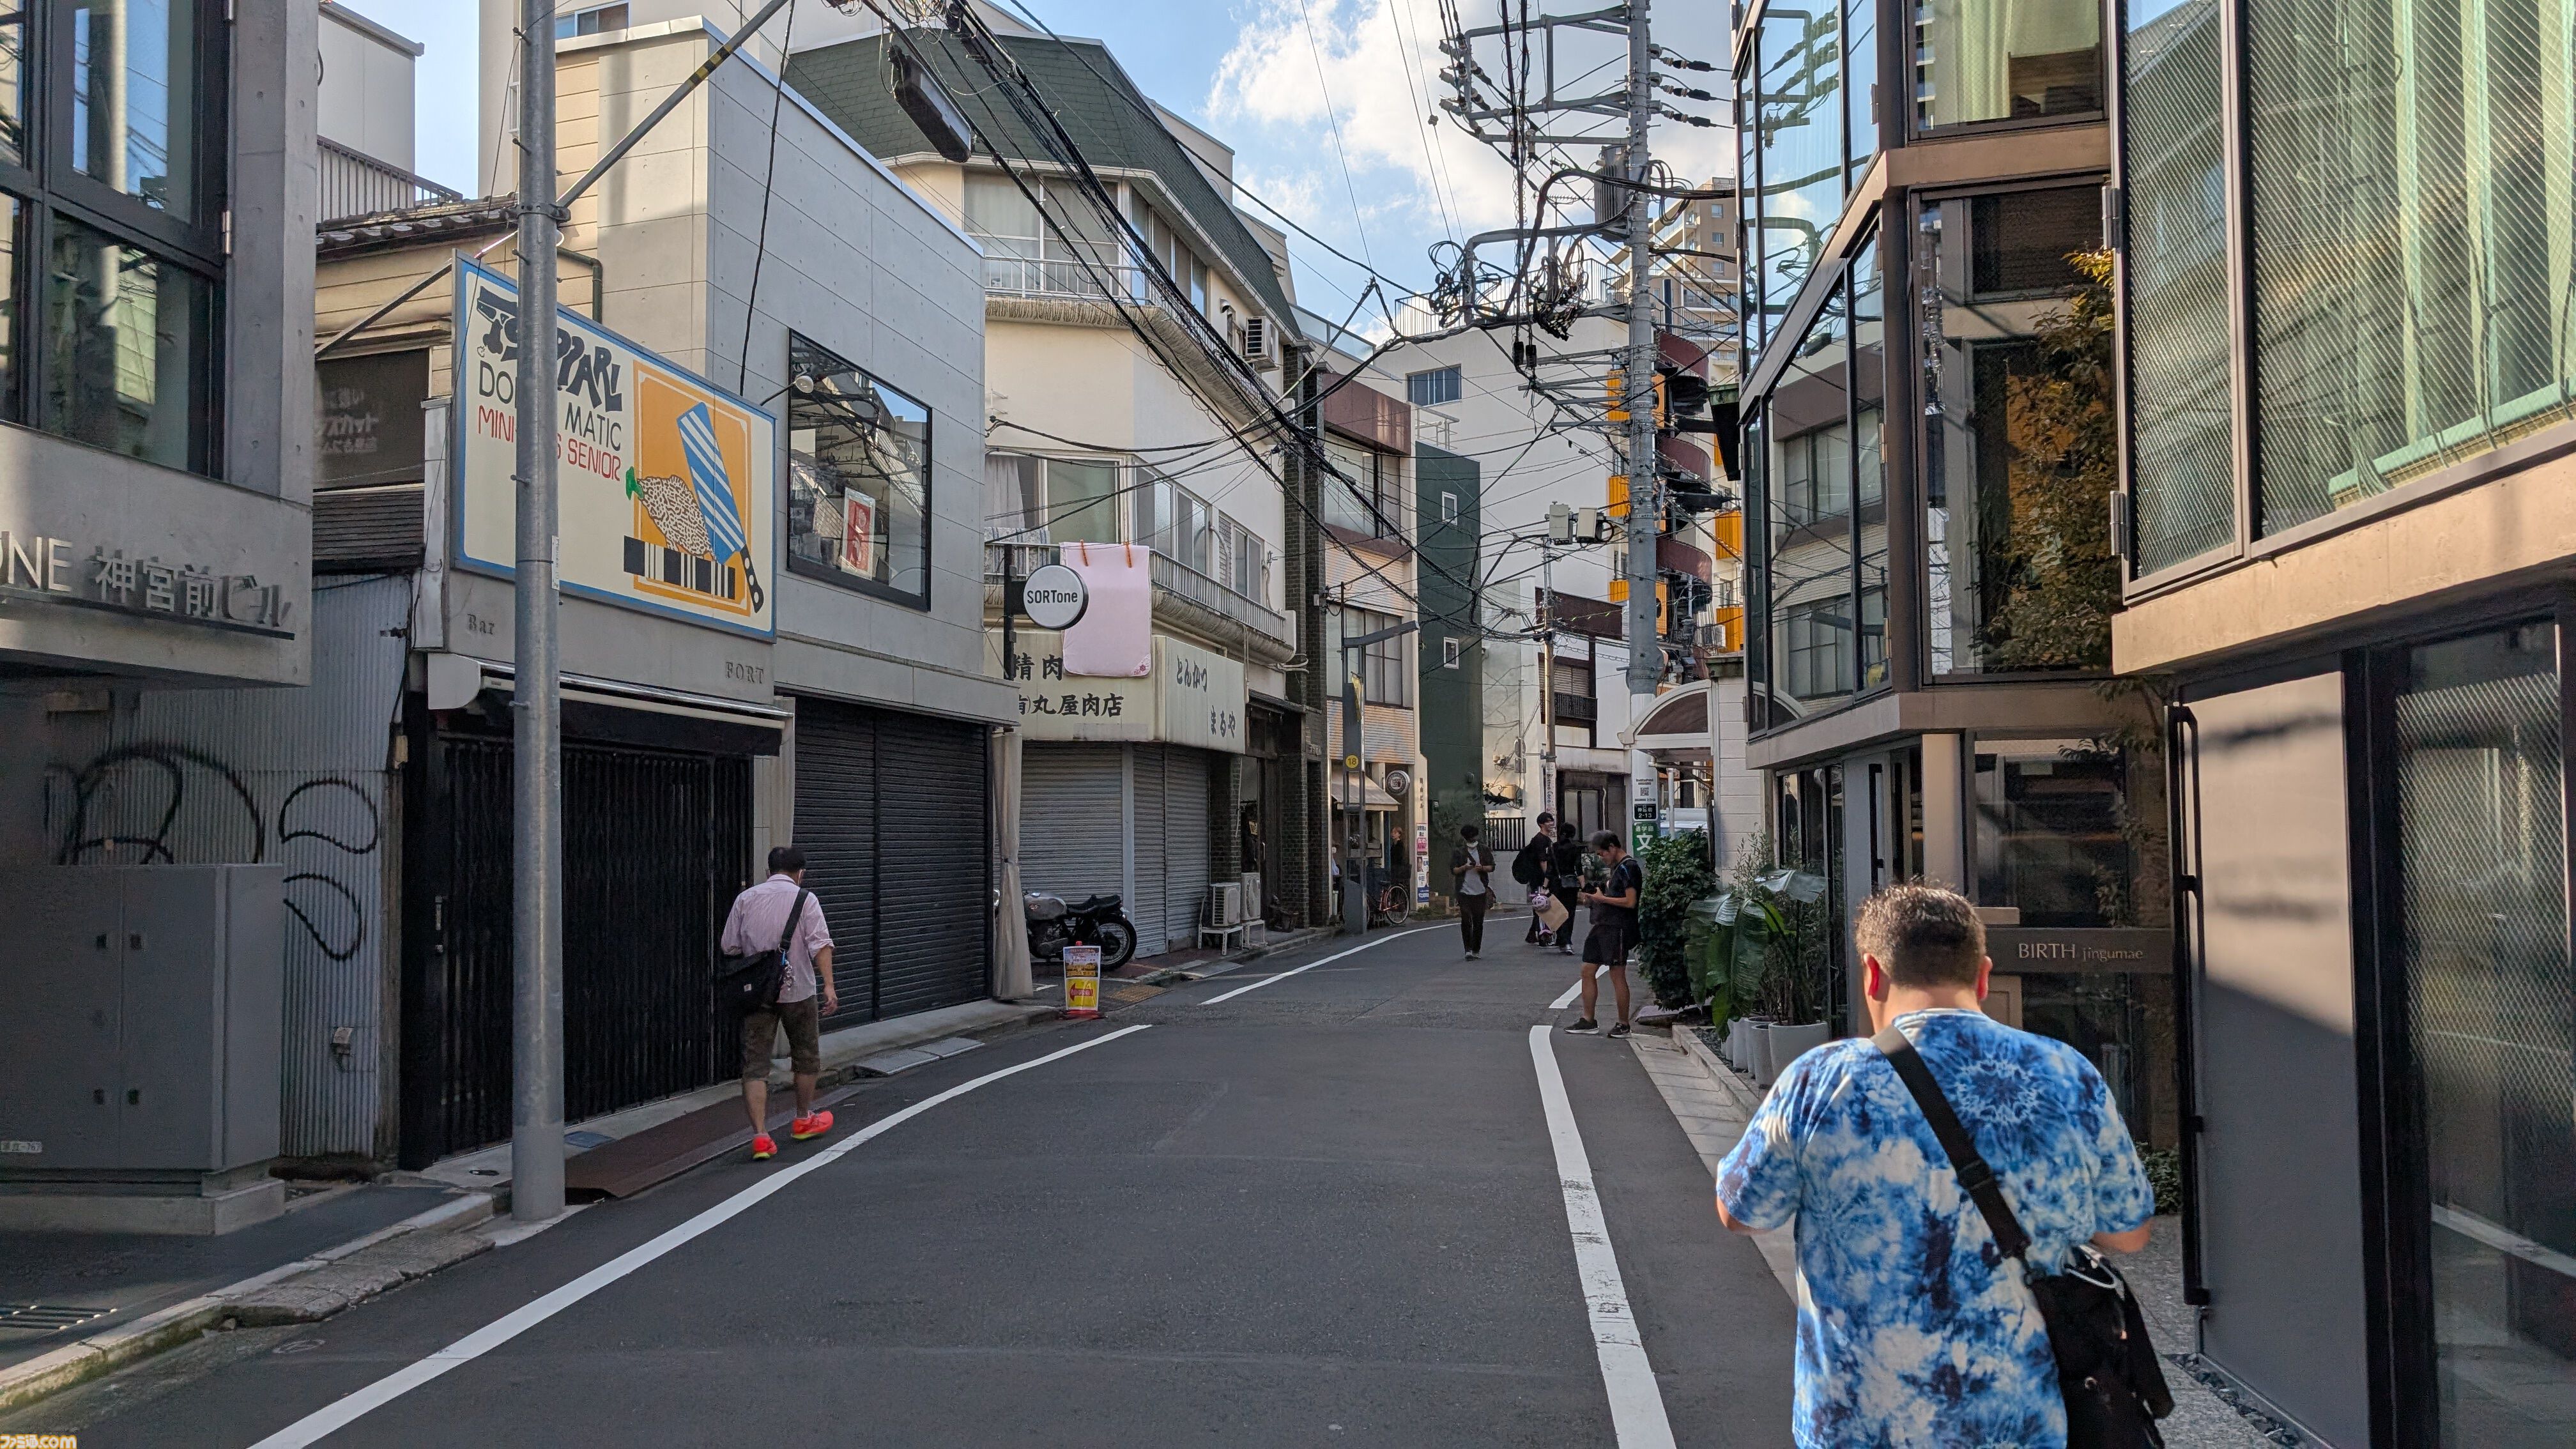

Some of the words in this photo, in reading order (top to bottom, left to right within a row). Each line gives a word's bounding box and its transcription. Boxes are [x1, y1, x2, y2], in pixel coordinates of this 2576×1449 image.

[565, 402, 622, 451] MATIC
[567, 438, 621, 482] SENIOR
[0, 530, 73, 592] NE
[93, 552, 293, 627] 神宮前ビル
[1027, 590, 1078, 604] SORTone
[468, 613, 494, 635] Bar
[725, 661, 764, 684] FORT
[1013, 652, 1063, 681] 精肉
[1176, 655, 1208, 693] とんかつ
[1210, 705, 1236, 739] まるや
[2018, 943, 2076, 958] BIRTH
[2082, 947, 2143, 962] jingumae
